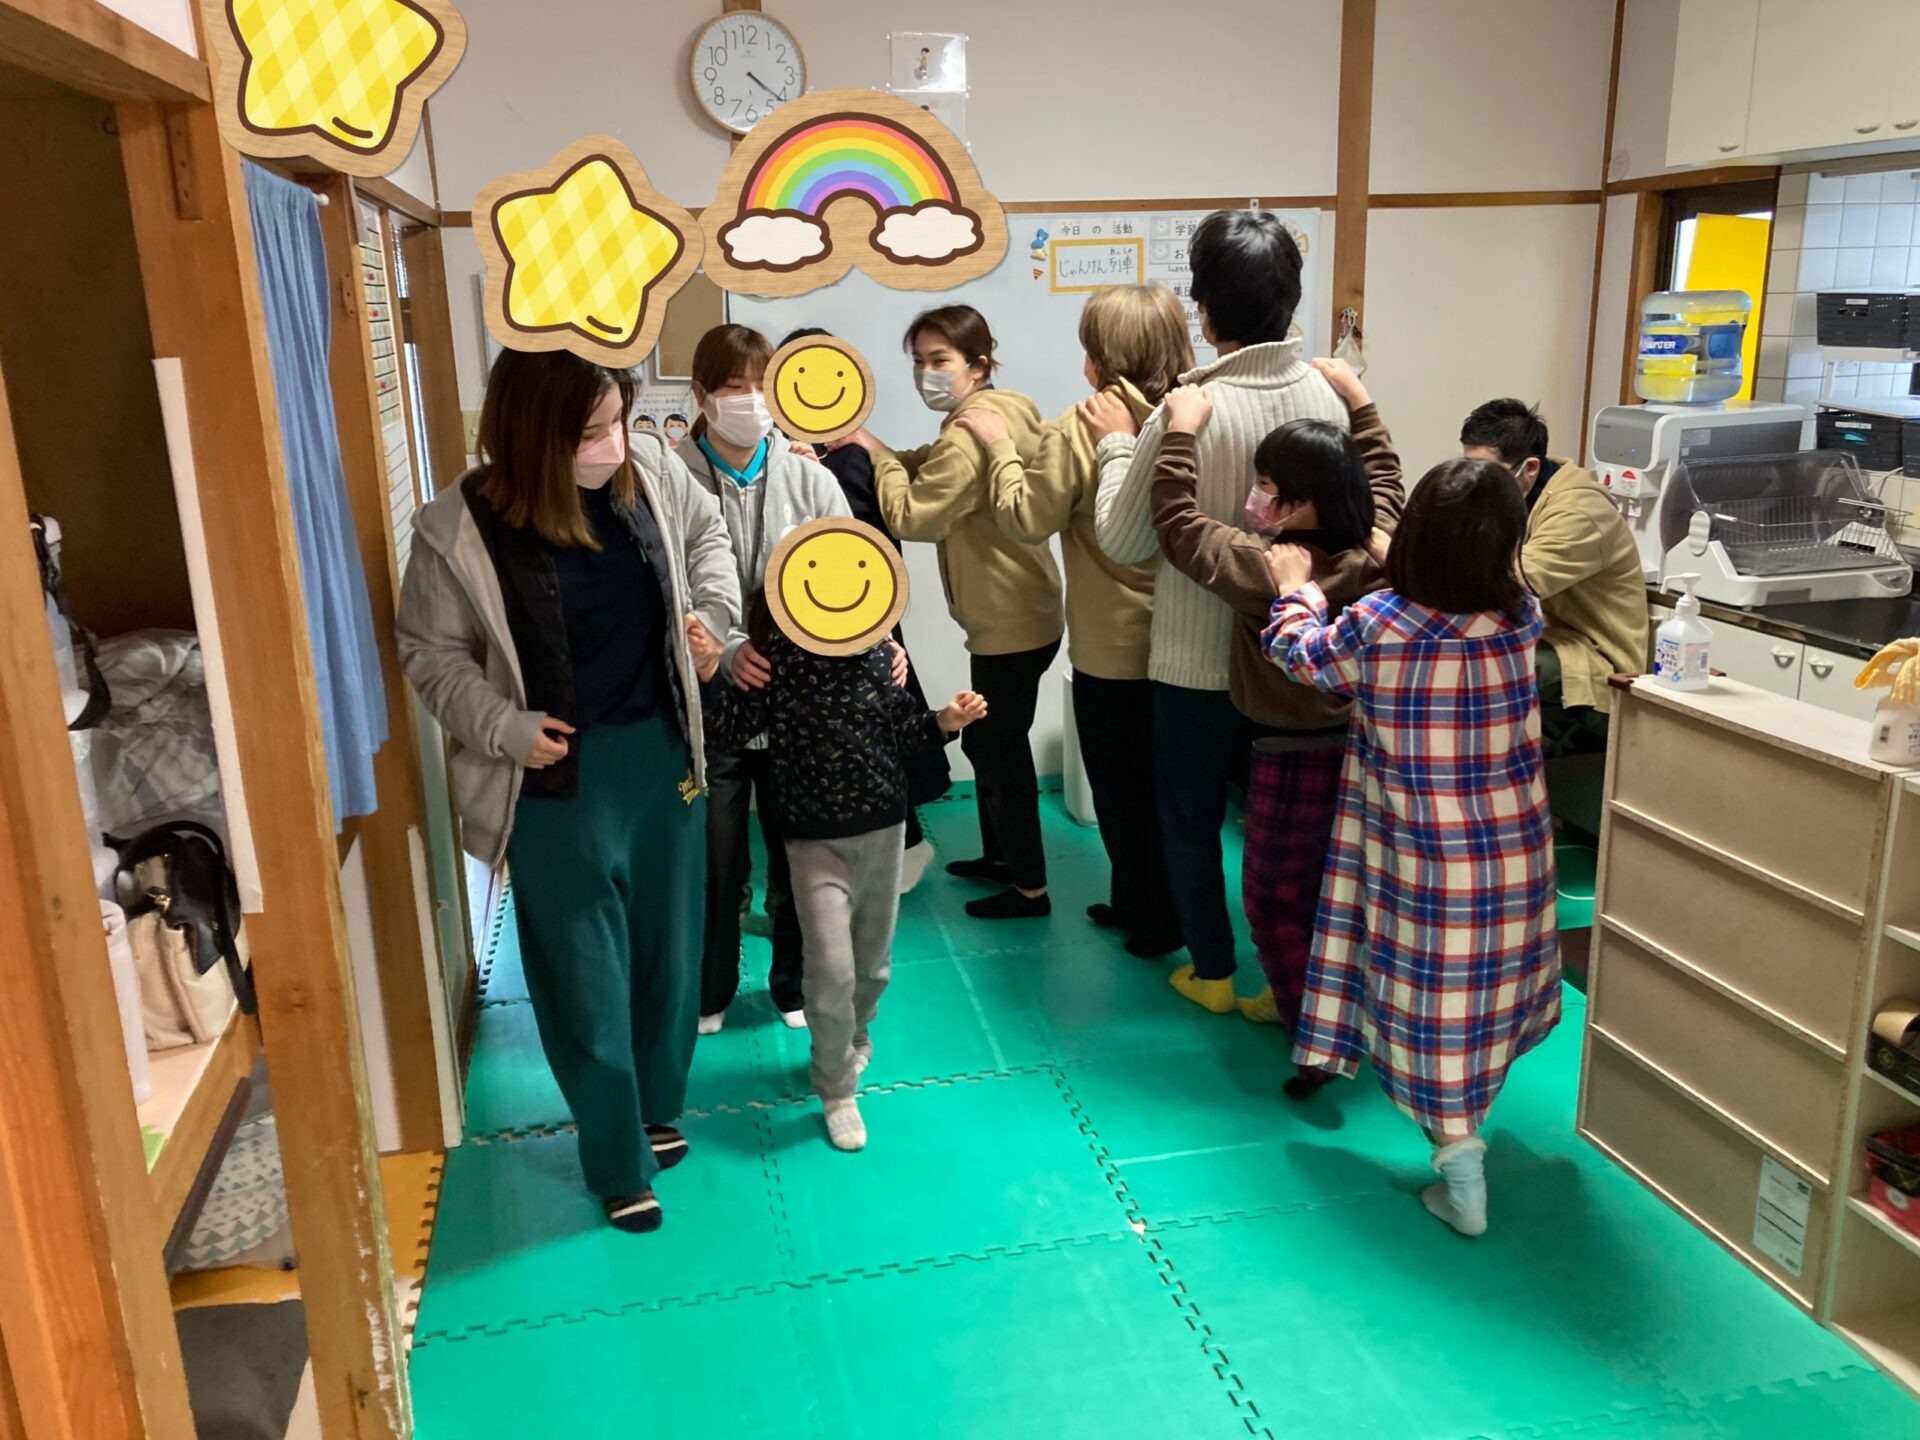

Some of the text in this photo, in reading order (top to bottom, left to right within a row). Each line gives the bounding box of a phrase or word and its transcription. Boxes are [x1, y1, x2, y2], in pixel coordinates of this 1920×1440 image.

[722, 30, 737, 50] 11
[740, 24, 758, 45] 12
[765, 31, 771, 51] 1
[708, 46, 728, 66] 10
[775, 43, 787, 64] 2
[704, 66, 717, 87] 9
[784, 65, 795, 86] 3
[713, 86, 725, 106] 8
[730, 98, 743, 118] 7
[745, 103, 758, 123] 6
[1062, 223, 1133, 236] 今日 の 活動
